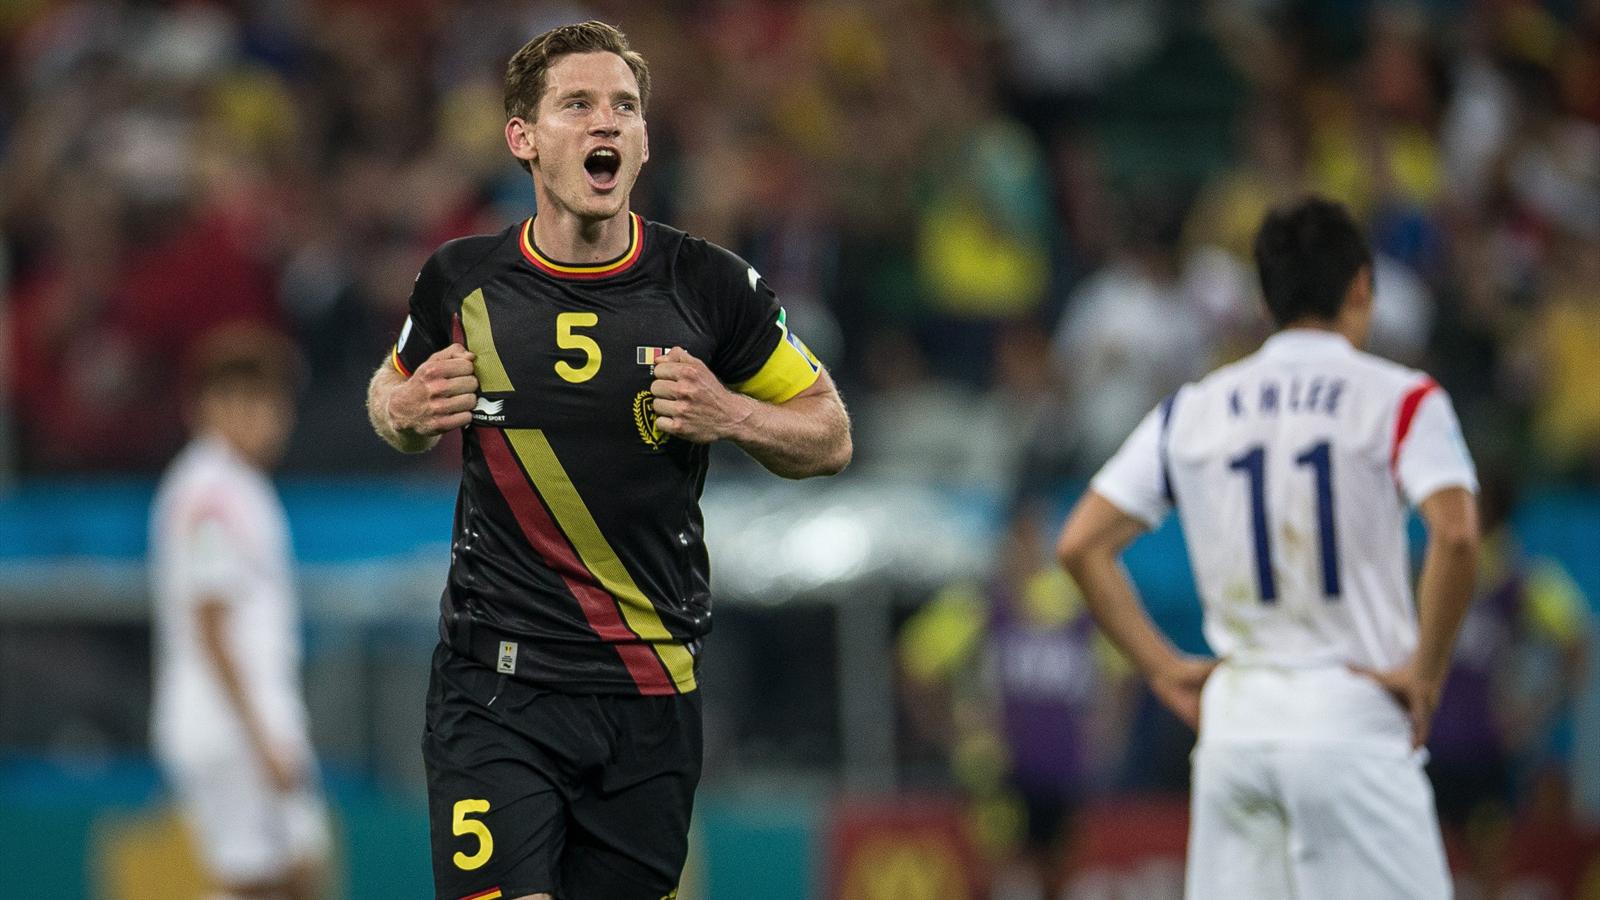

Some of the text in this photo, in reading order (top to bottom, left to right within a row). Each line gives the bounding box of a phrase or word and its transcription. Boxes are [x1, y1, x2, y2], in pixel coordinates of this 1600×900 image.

[554, 312, 602, 384] 5
[1228, 440, 1343, 606] 11
[453, 799, 494, 871] 5
